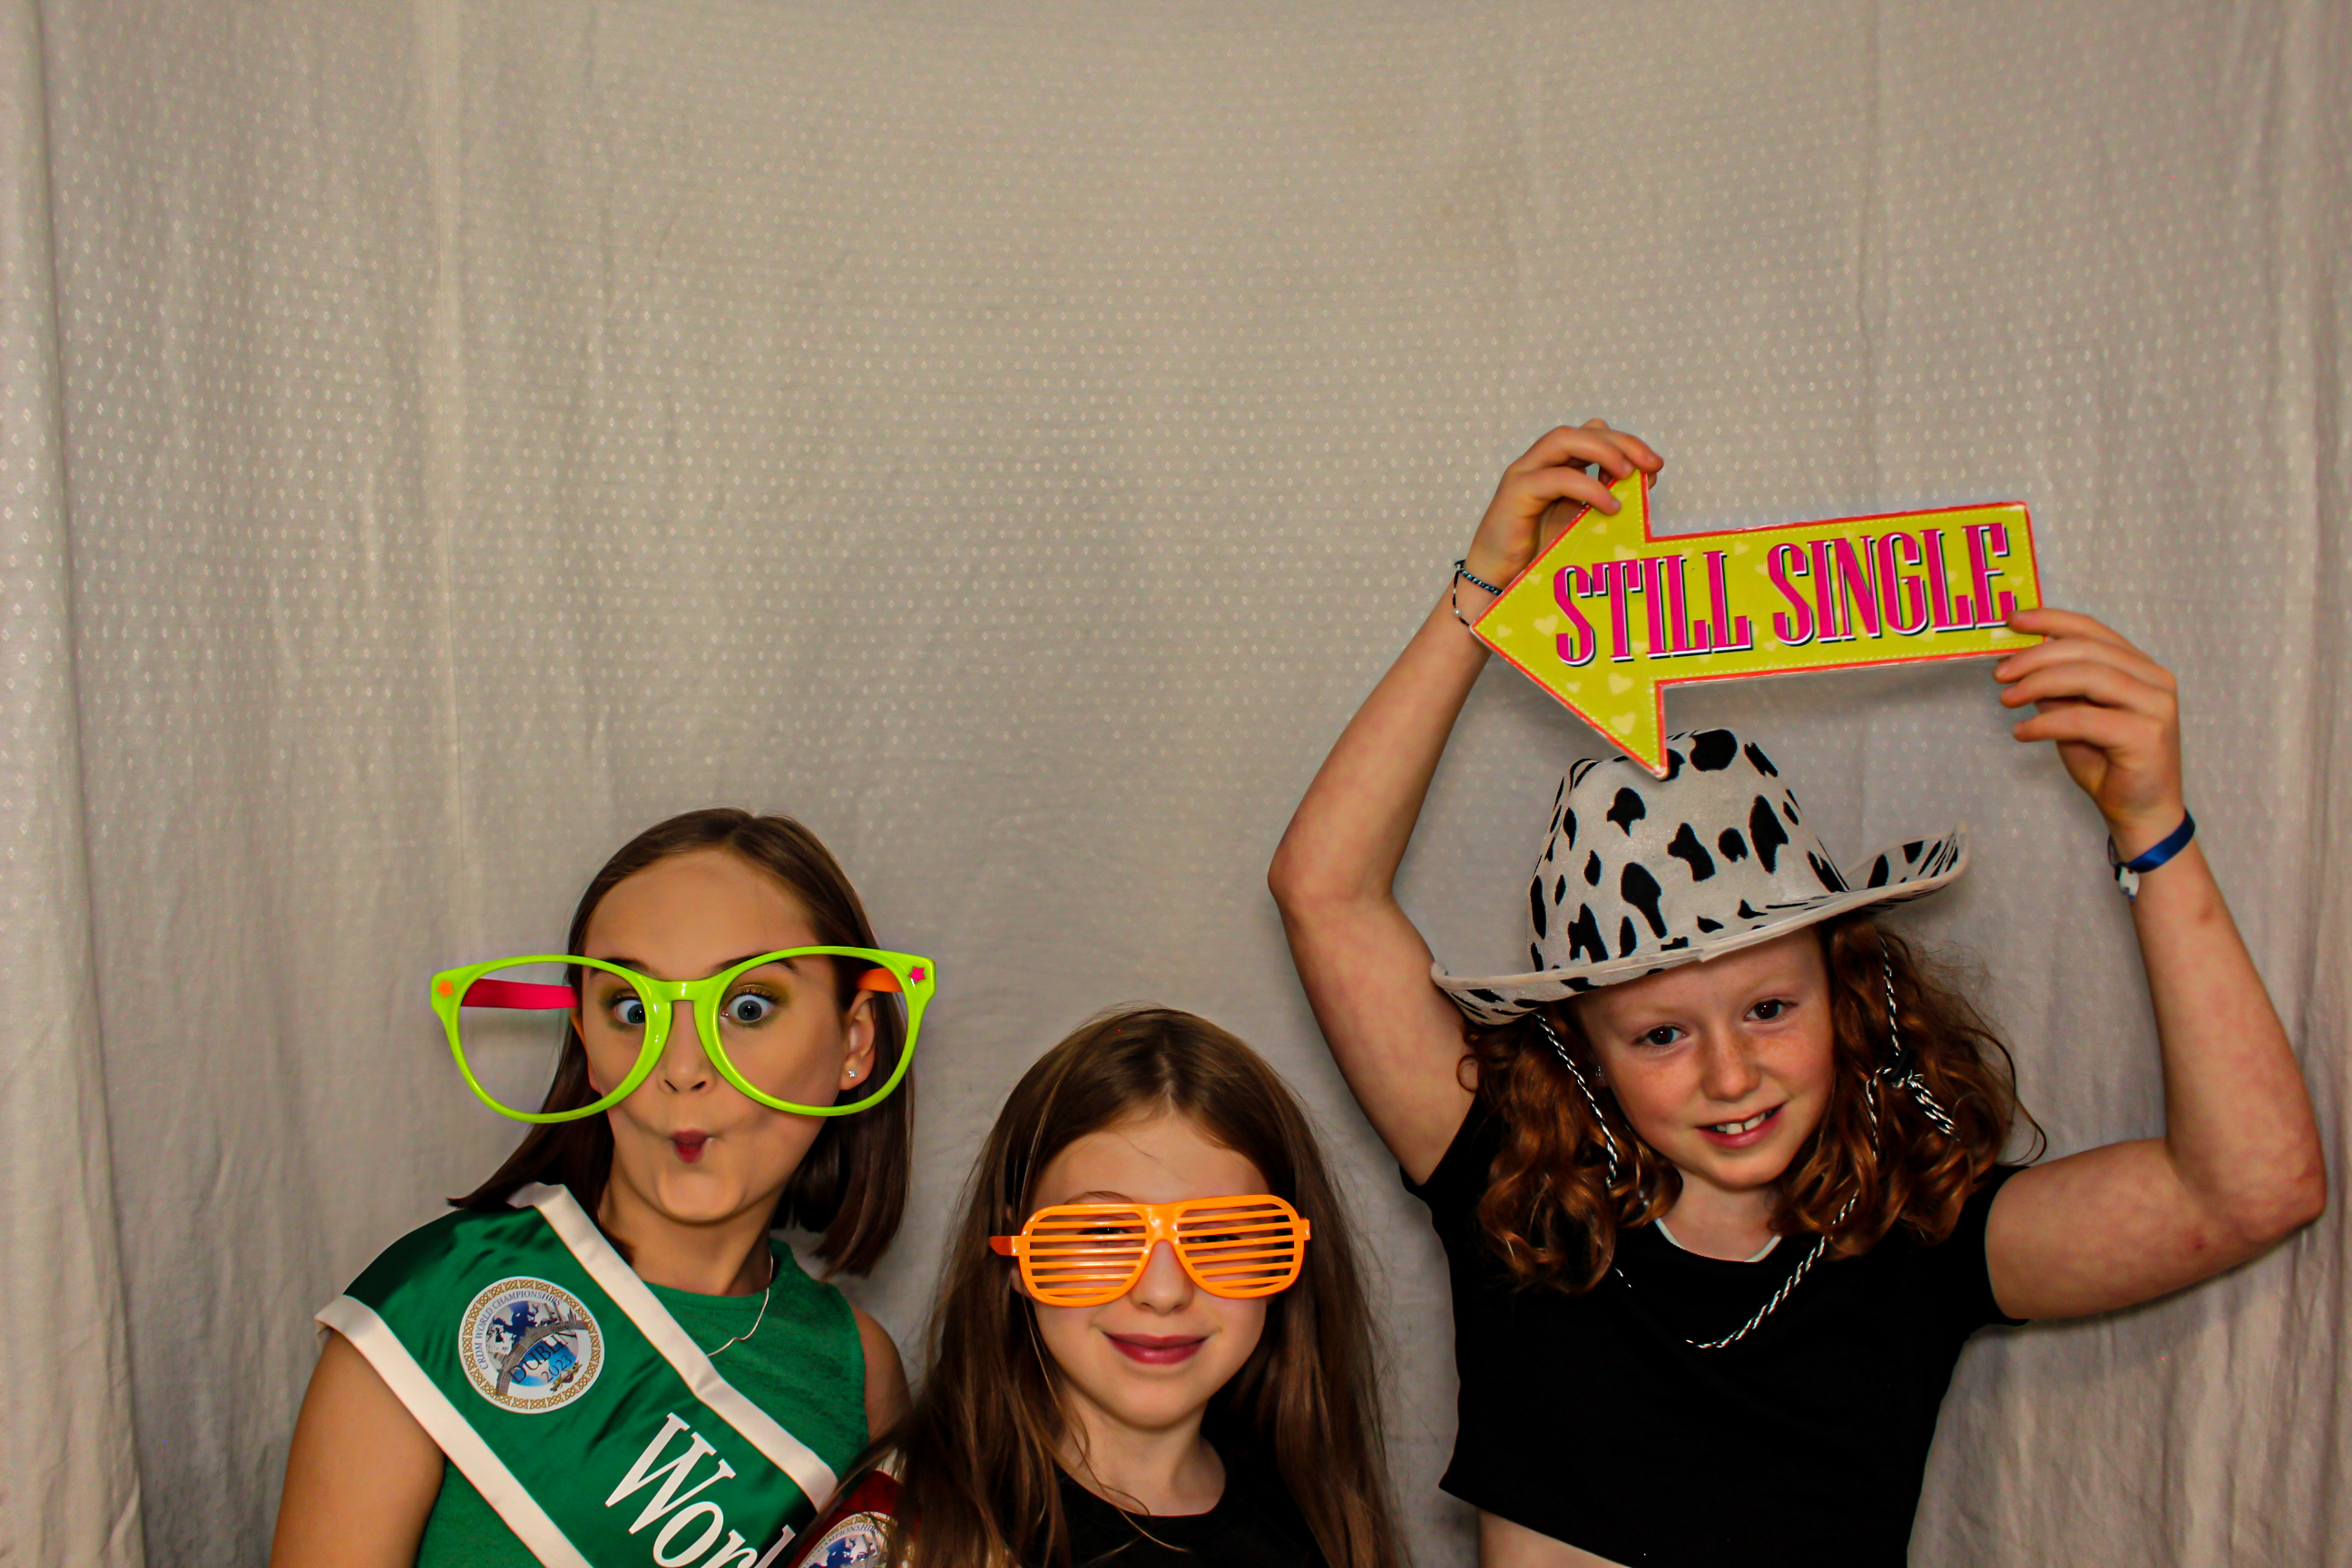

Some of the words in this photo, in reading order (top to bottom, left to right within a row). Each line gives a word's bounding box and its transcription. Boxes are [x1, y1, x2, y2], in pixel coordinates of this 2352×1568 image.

[1553, 549, 1754, 666] STILL
[1767, 523, 2018, 644] SINGLE
[492, 1290, 562, 1309] CHAMPIONSHIPS
[474, 1307, 495, 1338] WORLD
[475, 1339, 490, 1370] CRDM
[507, 1329, 578, 1385] DUBLIN
[541, 1355, 573, 1383] 2023
